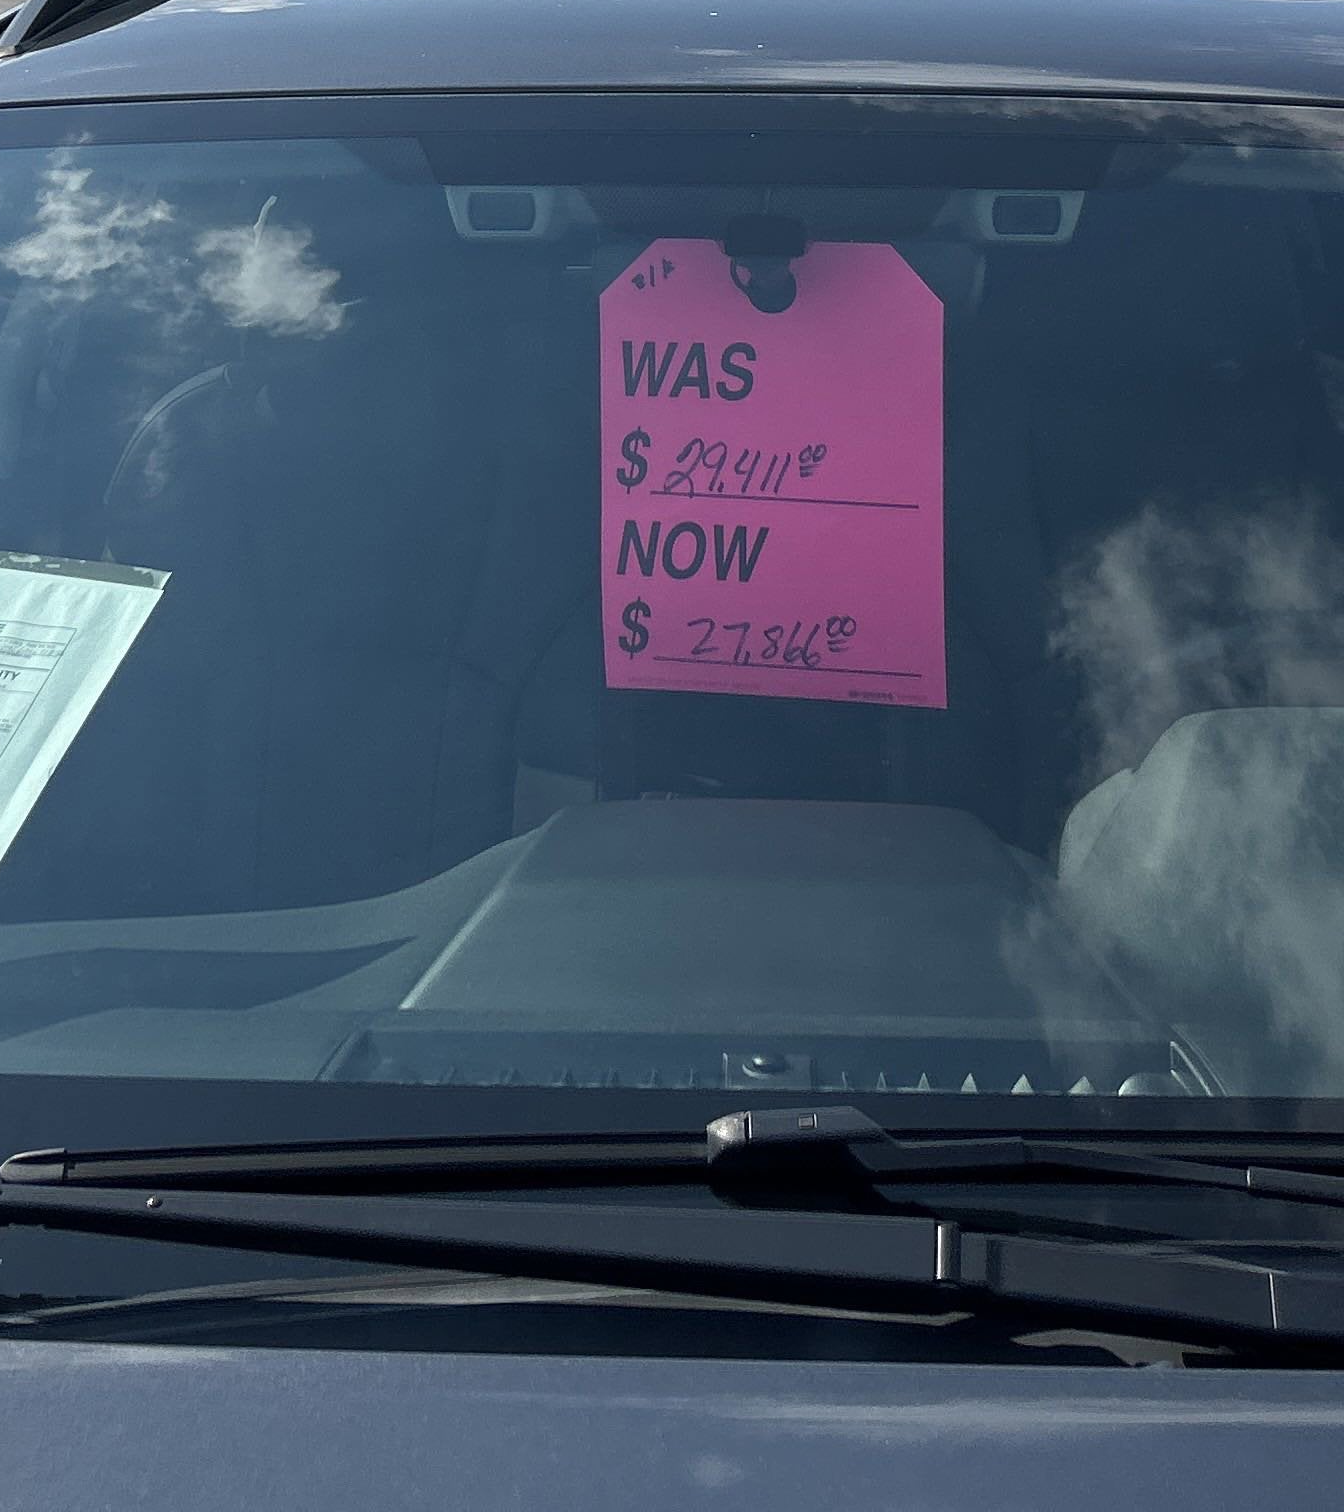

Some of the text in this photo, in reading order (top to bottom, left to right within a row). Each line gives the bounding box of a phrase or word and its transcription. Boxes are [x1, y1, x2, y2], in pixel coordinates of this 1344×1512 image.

[621, 340, 757, 401] WAS
[616, 426, 651, 494] $
[616, 519, 769, 583] NOW
[617, 596, 651, 659] $
